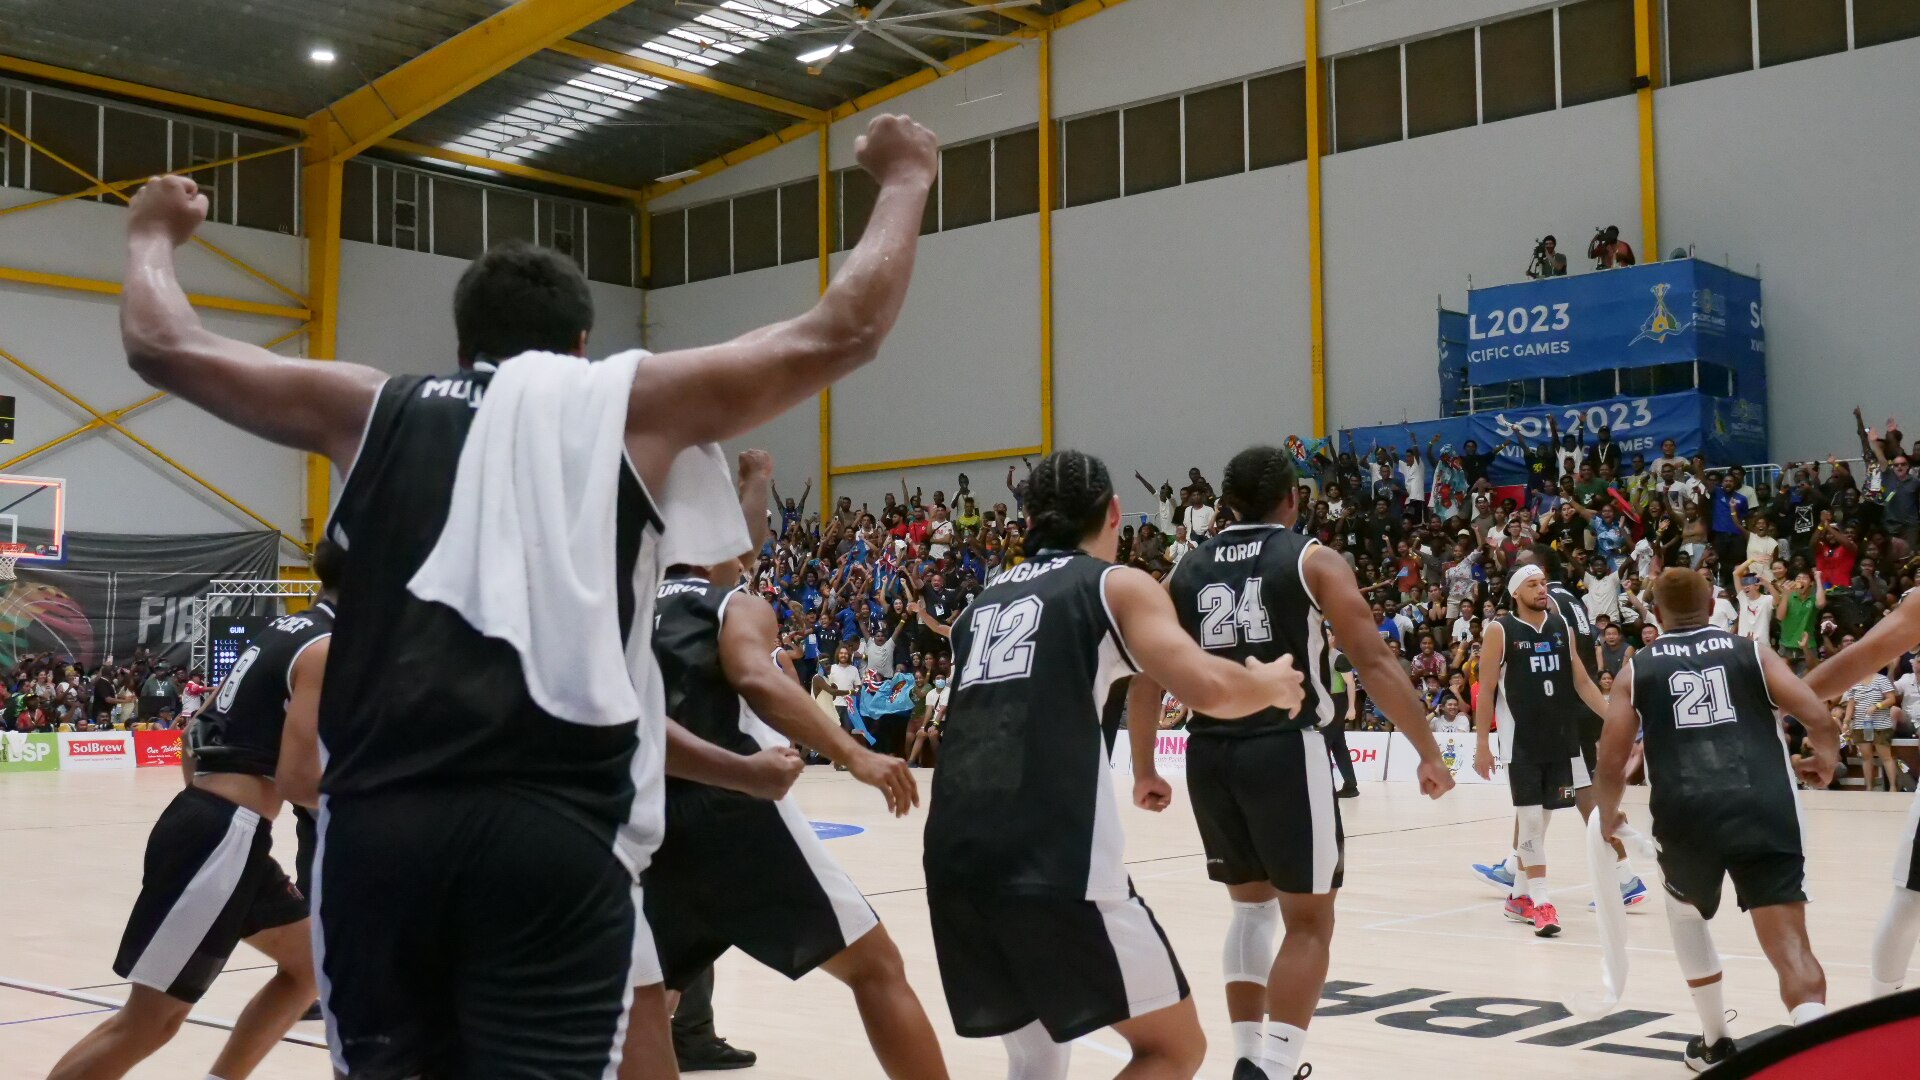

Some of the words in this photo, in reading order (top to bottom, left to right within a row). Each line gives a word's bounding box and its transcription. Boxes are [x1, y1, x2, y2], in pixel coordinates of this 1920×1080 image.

[1469, 303, 1570, 340] L2023
[1750, 302, 1764, 328] S
[1513, 341, 1570, 357] GAMES
[1214, 540, 1263, 562] KOROI
[1197, 577, 1273, 649] 24
[230, 626, 245, 634] GUM
[957, 594, 1044, 691] 12
[1651, 643, 1691, 657] LUM
[1695, 637, 1734, 655] KON
[1529, 654, 1560, 673] FIJI
[216, 646, 261, 714] 8
[1543, 679, 1555, 697] 0
[1668, 665, 1738, 730] 21
[72, 742, 123, 753] SolBrew
[1349, 749, 1376, 762] OH
